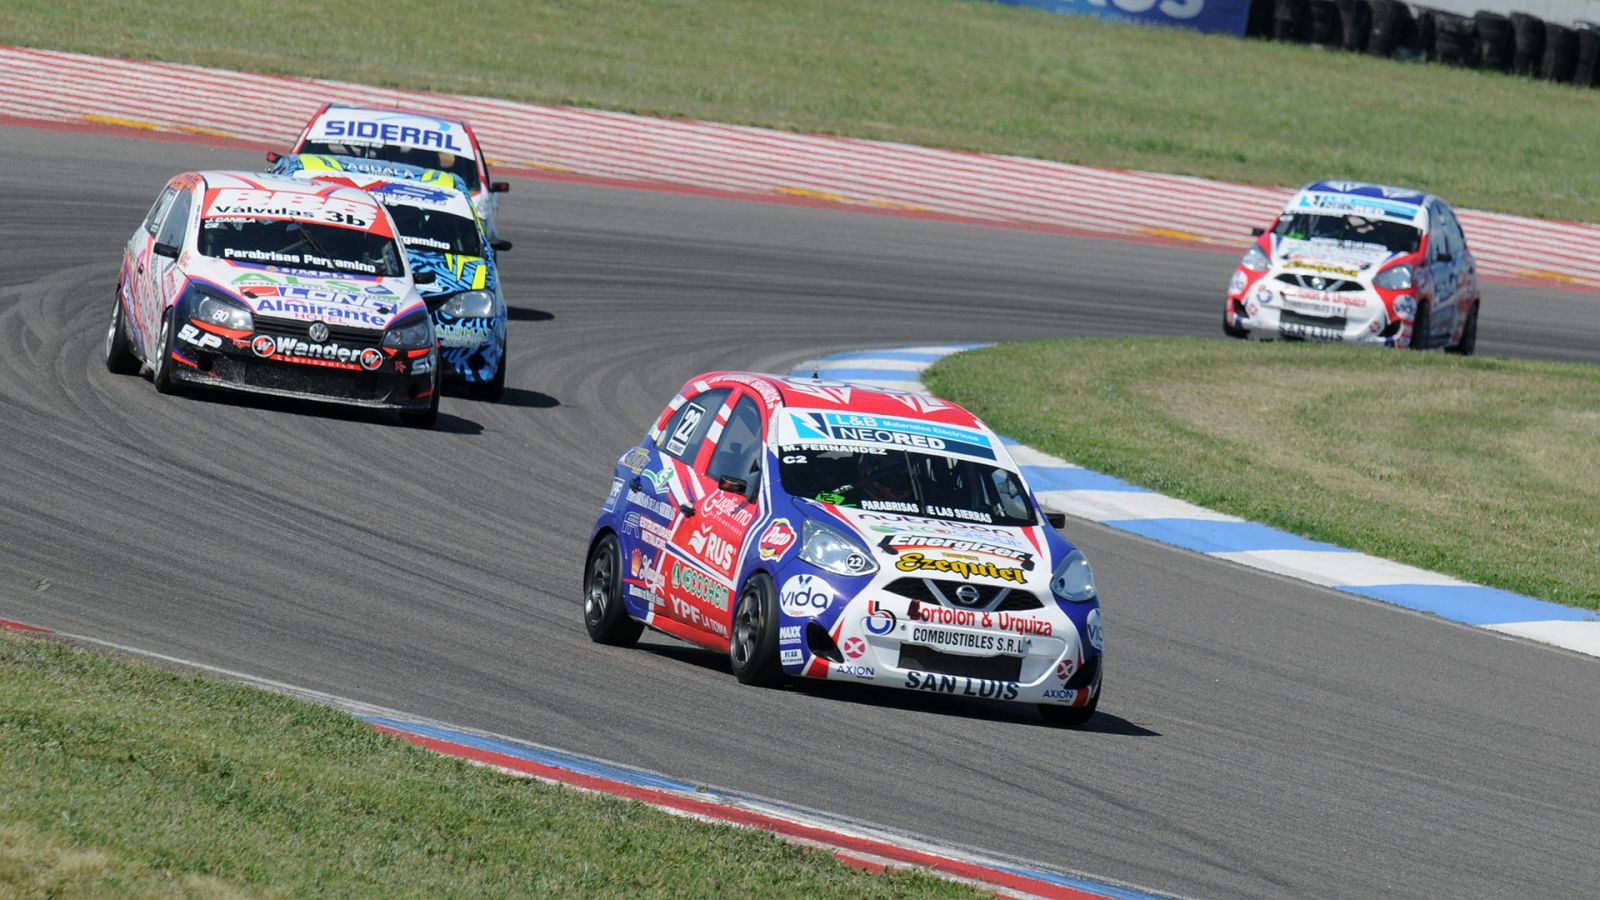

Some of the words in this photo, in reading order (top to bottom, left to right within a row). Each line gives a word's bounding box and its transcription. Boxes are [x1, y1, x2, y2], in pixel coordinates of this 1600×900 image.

[325, 120, 462, 152] SIDERAL
[209, 187, 378, 218] BBB
[326, 210, 367, 227] 3b
[224, 248, 300, 264] Parabrisas
[213, 309, 231, 322] 80
[256, 298, 386, 327] Almirante
[294, 312, 347, 325] HOTEL
[177, 323, 223, 349] SLP
[276, 336, 361, 362] Wander
[674, 409, 702, 442] 22
[836, 415, 878, 428] L&B
[883, 420, 932, 433] Materiales
[782, 444, 800, 453] M.
[802, 444, 888, 456] FERNANDEZ
[841, 428, 946, 450] NEORED
[782, 455, 808, 464] C2
[861, 500, 919, 514] PARABRISAS
[936, 507, 954, 518] LAS
[955, 508, 992, 524] SIERRAS
[705, 532, 734, 571] RUS
[848, 557, 863, 568] 22
[895, 552, 1029, 585] Ezequiel
[669, 592, 700, 625] YPF
[780, 586, 828, 610] vida
[914, 604, 975, 627] ortolon
[981, 610, 993, 628] &
[998, 611, 1053, 637] Urquiza
[779, 625, 802, 640] MAXX
[913, 628, 993, 650] COMBUSTIBLES
[835, 664, 875, 676] AXION
[904, 670, 956, 694] SAN
[963, 677, 1020, 701] LUIS
[1042, 688, 1074, 699] AXION
